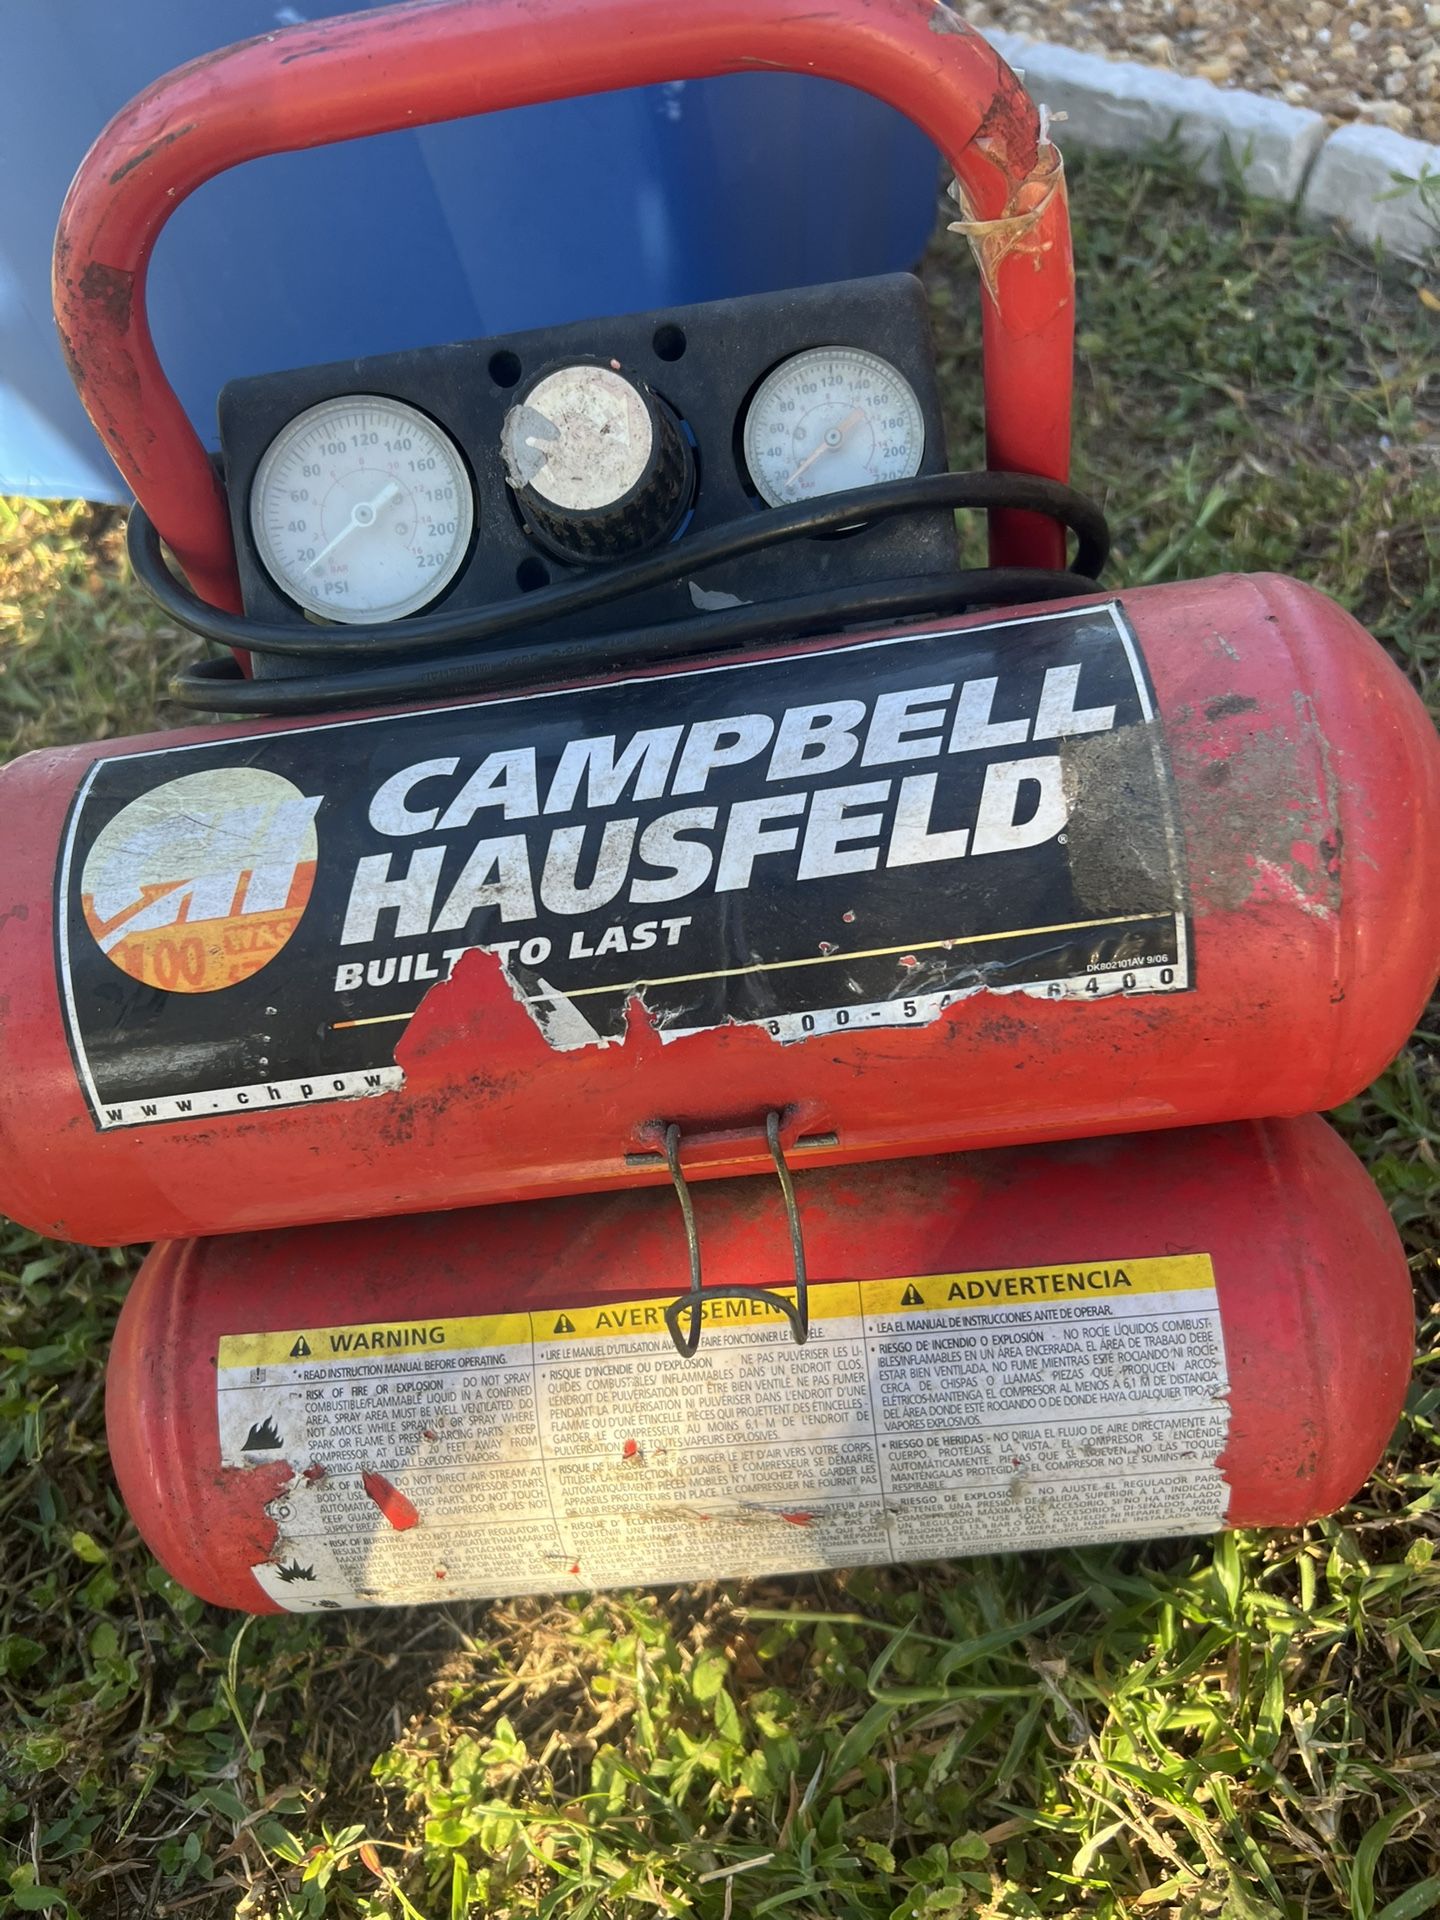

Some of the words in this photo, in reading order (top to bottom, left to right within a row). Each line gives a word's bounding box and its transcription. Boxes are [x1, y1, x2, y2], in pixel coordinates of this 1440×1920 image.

[821, 375, 843, 388] 120
[849, 379, 870, 392] 140
[795, 383, 817, 395] 100
[780, 401, 795, 412] 80
[866, 395, 888, 406] 160
[770, 423, 784, 433] 60
[882, 417, 904, 429] 180
[350, 432, 379, 447] 120
[384, 439, 412, 453] 140
[319, 442, 346, 456] 100
[767, 447, 782, 457] 40
[883, 446, 906, 458] 200
[303, 464, 320, 477] 80
[408, 458, 436, 472] 160
[774, 471, 789, 481] 20
[291, 489, 308, 502] 60
[426, 487, 453, 502] 180
[288, 520, 306, 533] 40
[428, 522, 455, 536] 200
[297, 548, 315, 562] 20
[417, 553, 443, 568] 220
[330, 565, 348, 573] BAR
[325, 581, 348, 595] PSI
[368, 663, 1117, 836] CAMPBELL
[340, 755, 1069, 946] HAUSFELD
[334, 946, 463, 992] BUILT
[569, 916, 693, 959] LAST
[1086, 957, 1145, 973] DK802101AV
[1146, 954, 1169, 965] 9/06
[946, 1268, 1132, 1300] ADVERTENCIA
[876, 1322, 893, 1333] LEA
[895, 1321, 905, 1332] EL
[906, 1318, 947, 1331] MANUAL
[948, 1317, 961, 1327] DE
[962, 1311, 1032, 1326] INSTRUCCIONES
[1033, 1309, 1059, 1321] ANTE
[1060, 1308, 1072, 1319] DE
[329, 1326, 445, 1352] WARNING
[545, 1349, 560, 1359] LIRE
[562, 1348, 570, 1358] LE
[572, 1345, 605, 1357] MANUEL
[701, 1336, 721, 1347] FAIRE
[723, 1332, 777, 1345] FONCTIONNER
[779, 1331, 788, 1341] LE
[878, 1341, 912, 1354] RIESGO
[916, 1339, 929, 1351] DE
[931, 1336, 976, 1350] INCENDIO
[980, 1335, 988, 1346] O
[991, 1328, 1044, 1345] EXPLOSIÓN
[1063, 1328, 1078, 1339] NO
[964, 1350, 976, 1361] EN
[979, 1348, 994, 1360] UN
[1086, 1340, 1097, 1351] EL
[1128, 1337, 1141, 1348] DE
[1143, 1333, 1186, 1347] TRABAJO
[1189, 1331, 1213, 1343] DEBE
[303, 1368, 326, 1380] READ
[328, 1364, 383, 1378] INSTRUCTION
[384, 1361, 423, 1374] MANUAL
[424, 1358, 456, 1371] BEFORE
[550, 1368, 581, 1381] RISQUE
[636, 1362, 651, 1373] OU
[740, 1354, 752, 1365] NE
[756, 1352, 774, 1364] PAS
[832, 1347, 847, 1358] LES
[547, 1380, 581, 1393] QUIDES
[740, 1366, 765, 1378] DANS
[770, 1364, 784, 1376] UN
[791, 1361, 831, 1374] ENDROIT
[306, 1389, 324, 1399] RISK
[331, 1387, 343, 1397] OF
[351, 1385, 368, 1396] FIRE
[375, 1384, 388, 1394] OR
[396, 1379, 443, 1392] EXPLOSION
[462, 1377, 477, 1387] DO
[481, 1375, 500, 1386] NOT
[504, 1373, 531, 1384] SPRAY
[426, 1391, 456, 1403] LIQUID
[461, 1390, 470, 1401] IN
[474, 1389, 482, 1400] A
[486, 1385, 532, 1399] CONFINED
[334, 1411, 360, 1423] SPRAY
[364, 1409, 388, 1421] AREA
[391, 1407, 417, 1419] MUST
[420, 1406, 430, 1416] BE
[434, 1404, 458, 1415] WELL
[519, 1398, 533, 1409] DO
[889, 1438, 923, 1450] RIESGO
[926, 1437, 939, 1447] DE
[942, 1434, 983, 1446] HERIDAS
[993, 1432, 1008, 1442] NO
[1044, 1428, 1054, 1438] EL
[1057, 1426, 1087, 1437] FLUJO
[1090, 1424, 1103, 1434] DE
[1106, 1422, 1128, 1433] AIRE
[1208, 1415, 1221, 1425] AL
